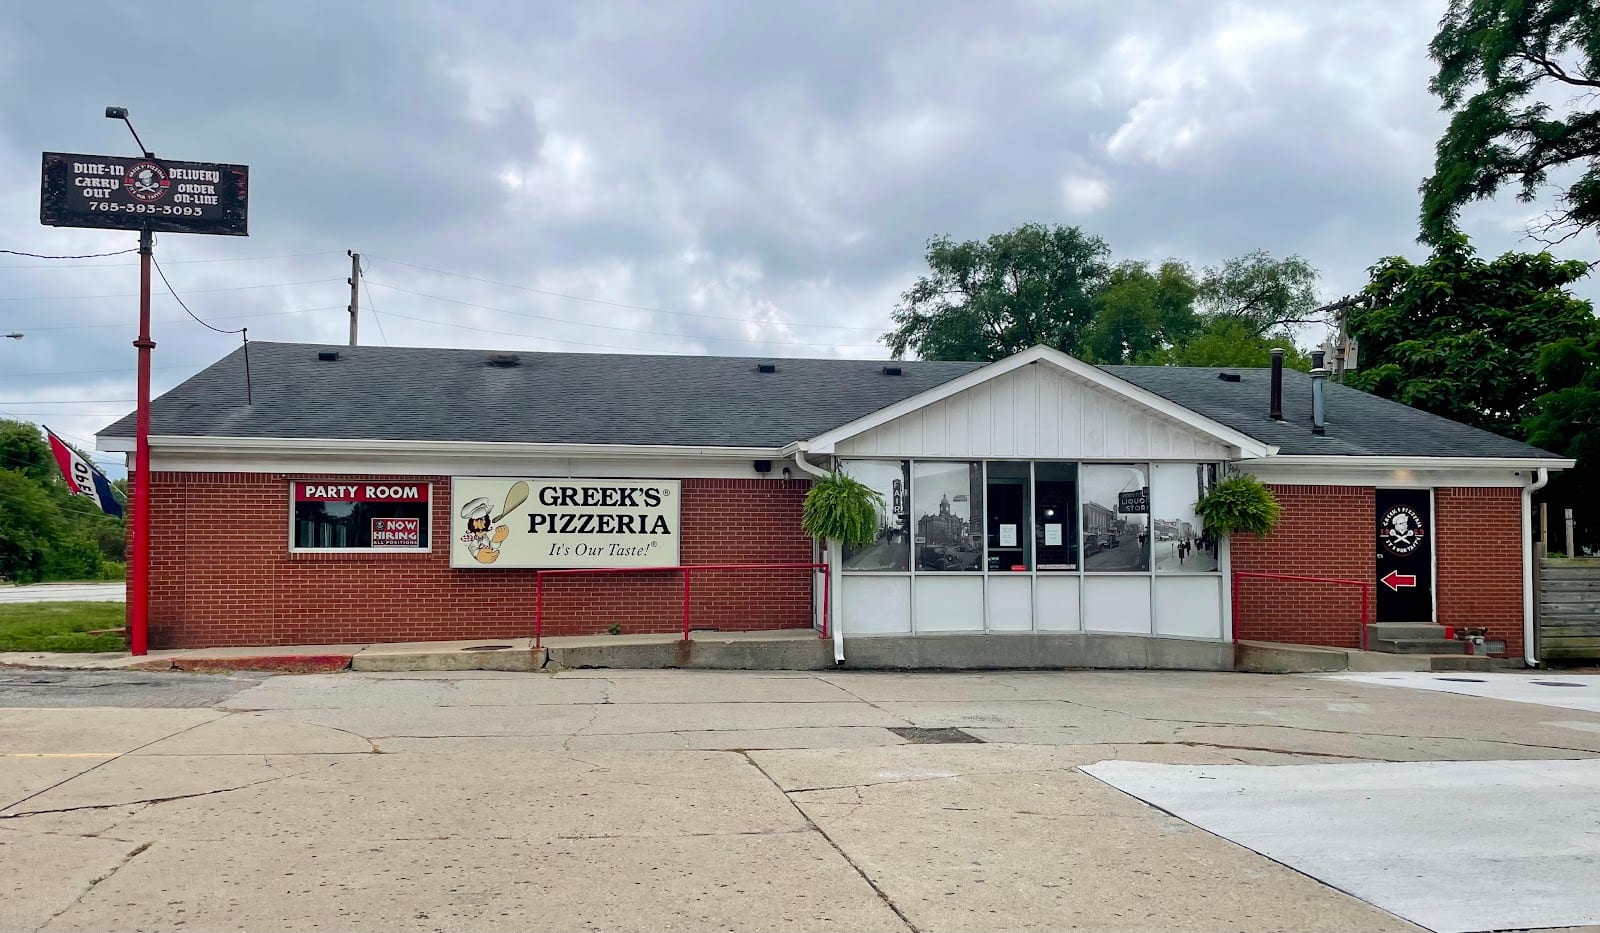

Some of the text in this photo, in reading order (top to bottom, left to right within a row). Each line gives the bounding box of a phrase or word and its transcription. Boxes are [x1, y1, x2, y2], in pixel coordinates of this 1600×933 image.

[73, 163, 125, 175] DINE-IN
[168, 168, 220, 183] DELIVERY
[74, 177, 120, 190] CARRY
[177, 183, 215, 195] ORDER
[83, 188, 112, 198] OUT
[173, 193, 219, 205] ON-LINE
[89, 201, 202, 216] 765-393-3093
[305, 485, 418, 499] PARTY ROOM
[387, 521, 417, 530] NOW
[527, 513, 671, 534] PIZZERIA
[373, 531, 417, 540] HIRING
[548, 542, 570, 556] It's
[575, 542, 604, 556] Our
